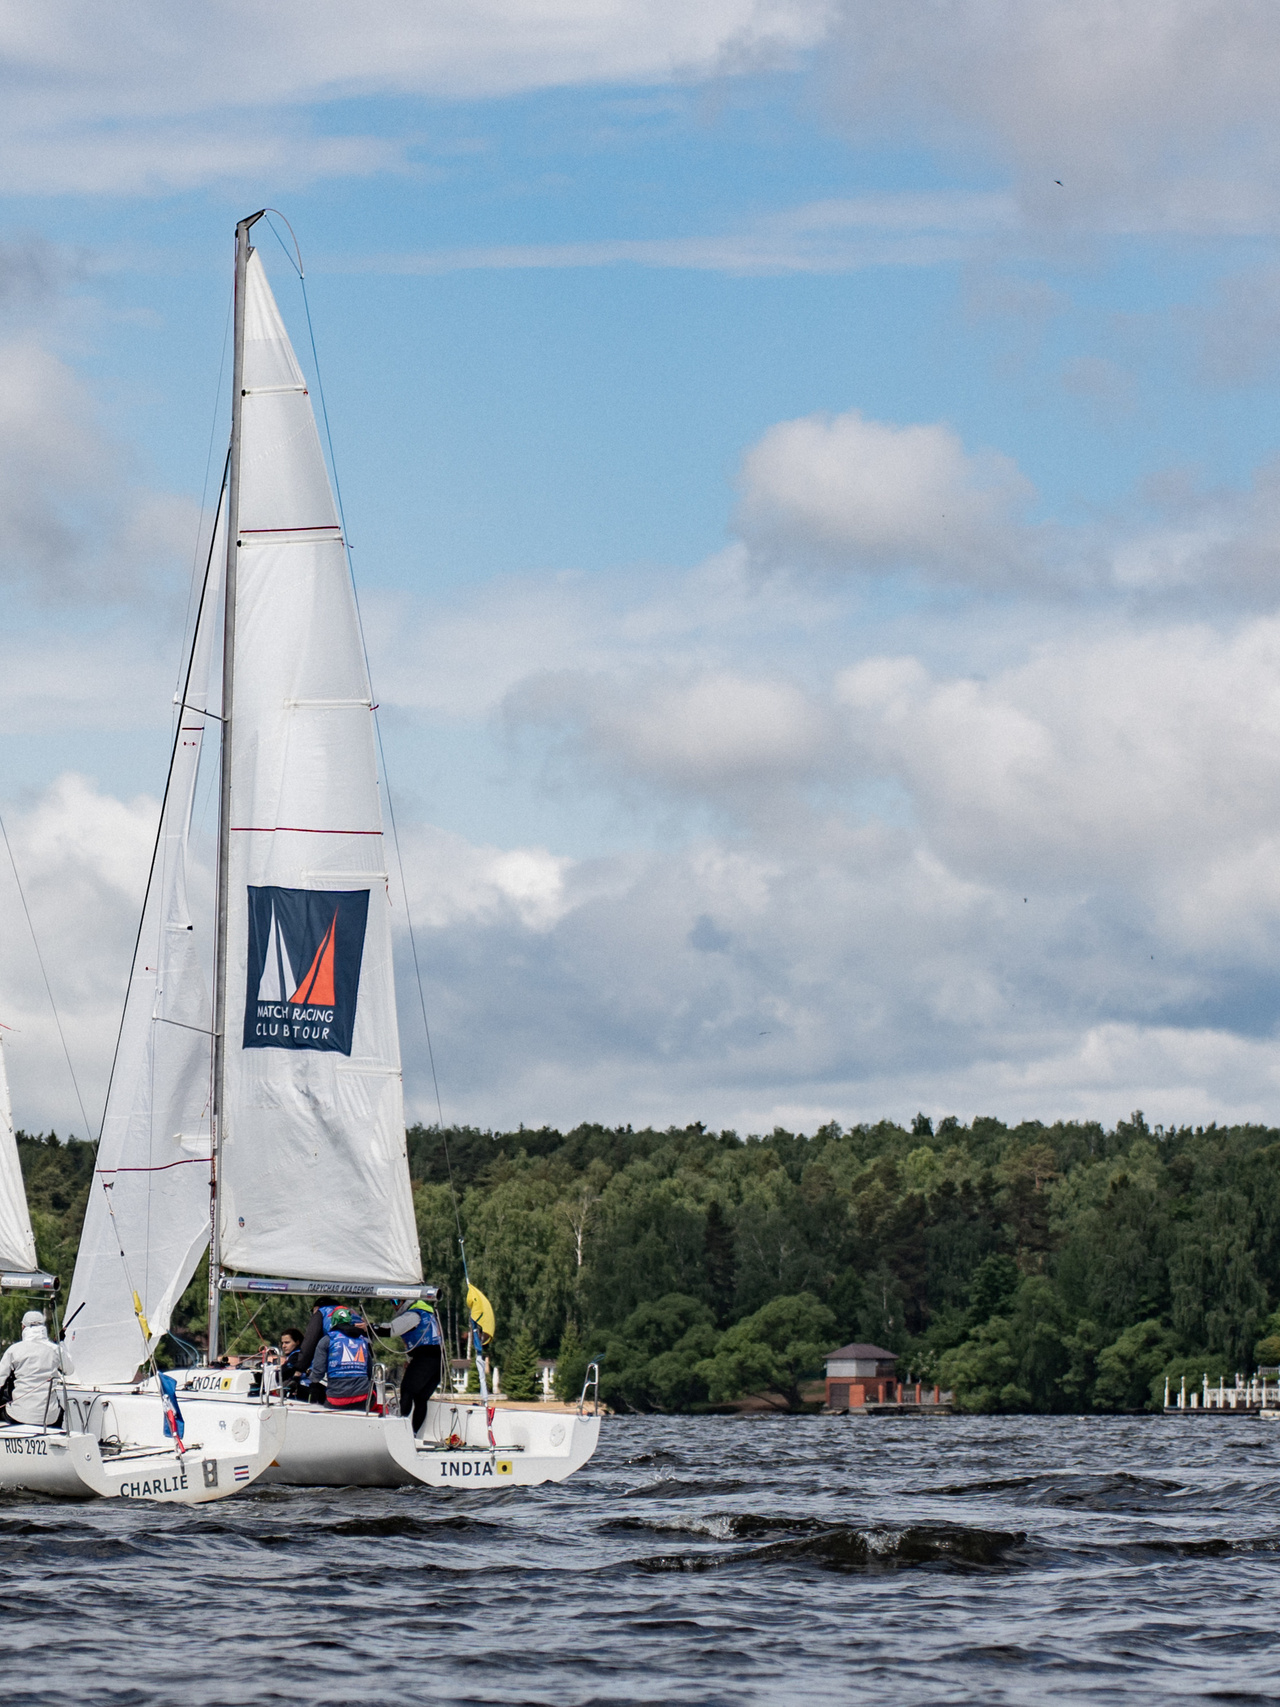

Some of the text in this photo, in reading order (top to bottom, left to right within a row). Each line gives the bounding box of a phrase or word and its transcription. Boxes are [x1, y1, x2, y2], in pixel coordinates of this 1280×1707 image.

[257, 1005, 334, 1023] MATCH RACING
[192, 1376, 222, 1390] INDIA
[5, 1438, 48, 1456] RUS 2922
[440, 1461, 493, 1477] INDIA
[120, 1474, 189, 1498] CHARLIE
